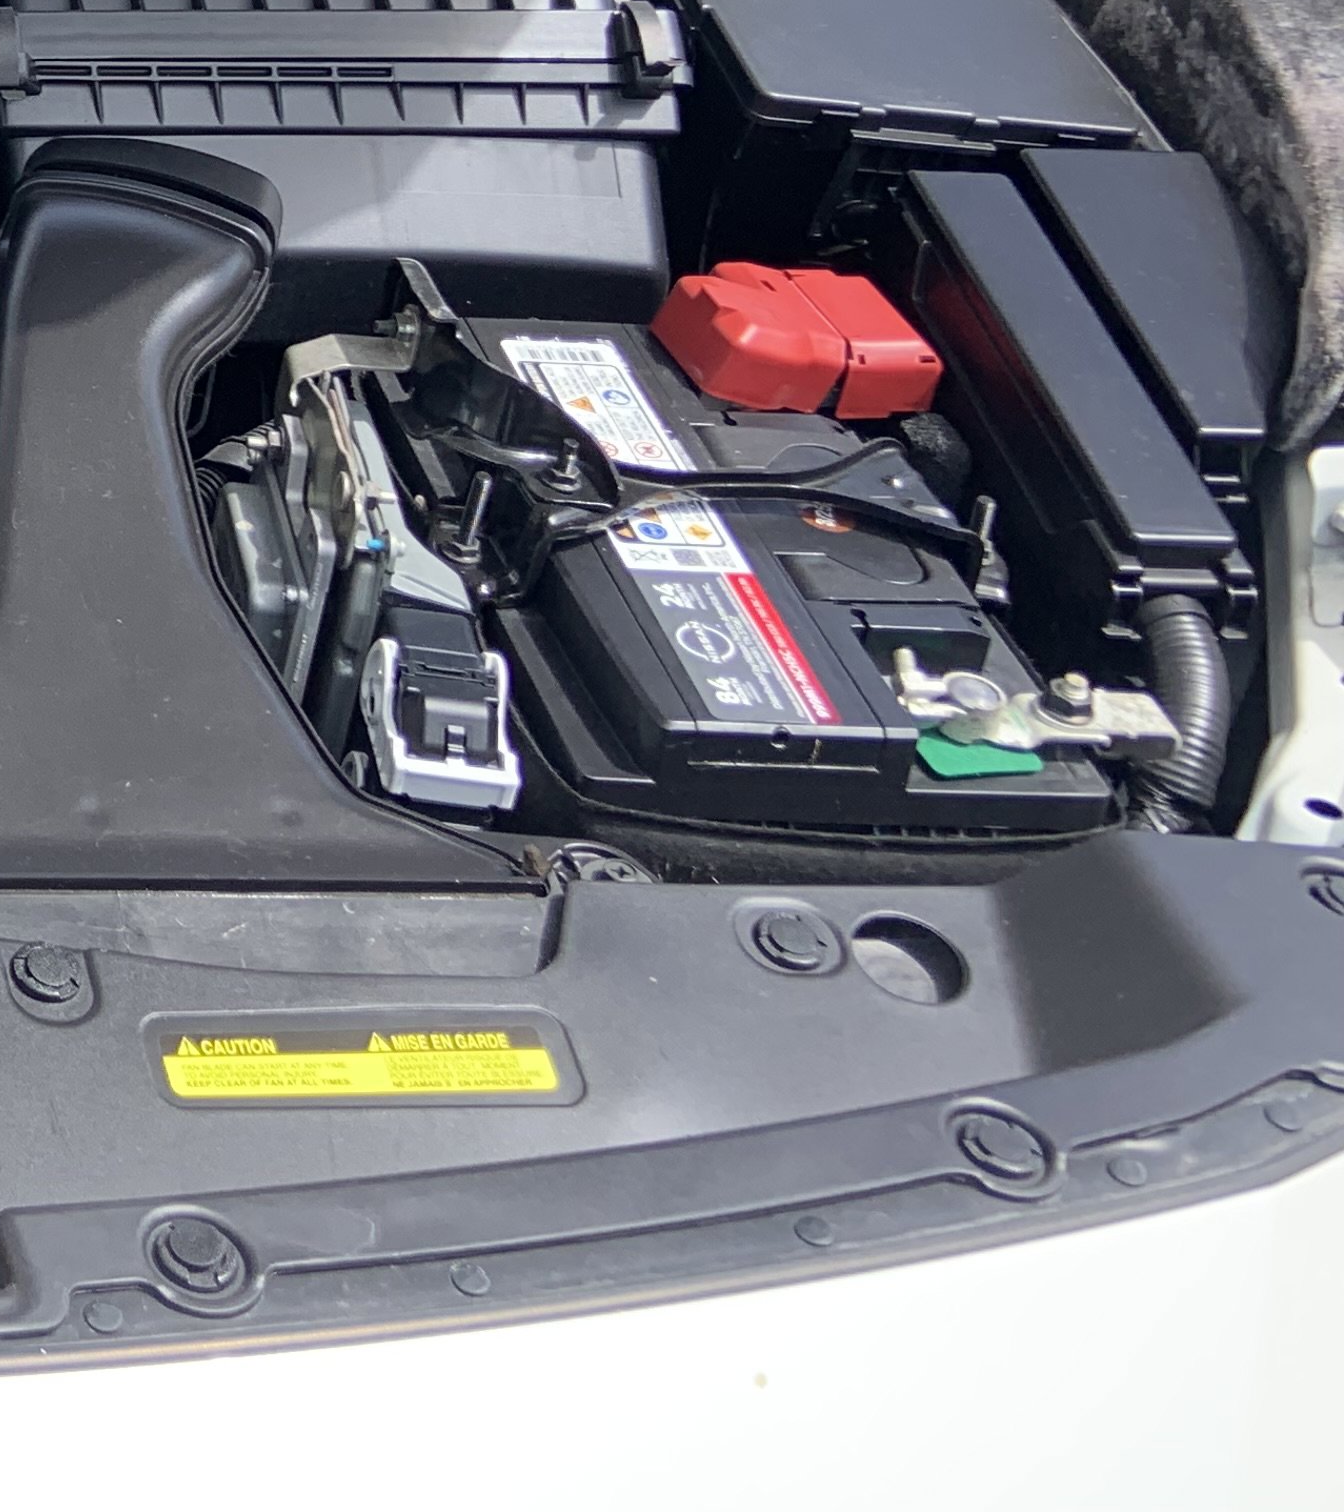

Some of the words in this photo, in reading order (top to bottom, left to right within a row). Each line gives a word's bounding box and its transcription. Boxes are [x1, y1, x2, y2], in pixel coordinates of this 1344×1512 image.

[650, 582, 685, 607] 24
[685, 620, 722, 663] NISSAN
[704, 676, 742, 704] 84
[201, 1039, 278, 1055] CAUTION
[390, 1035, 430, 1050] MISE
[430, 1034, 454, 1050] EN
[452, 1033, 511, 1049] GARDE
